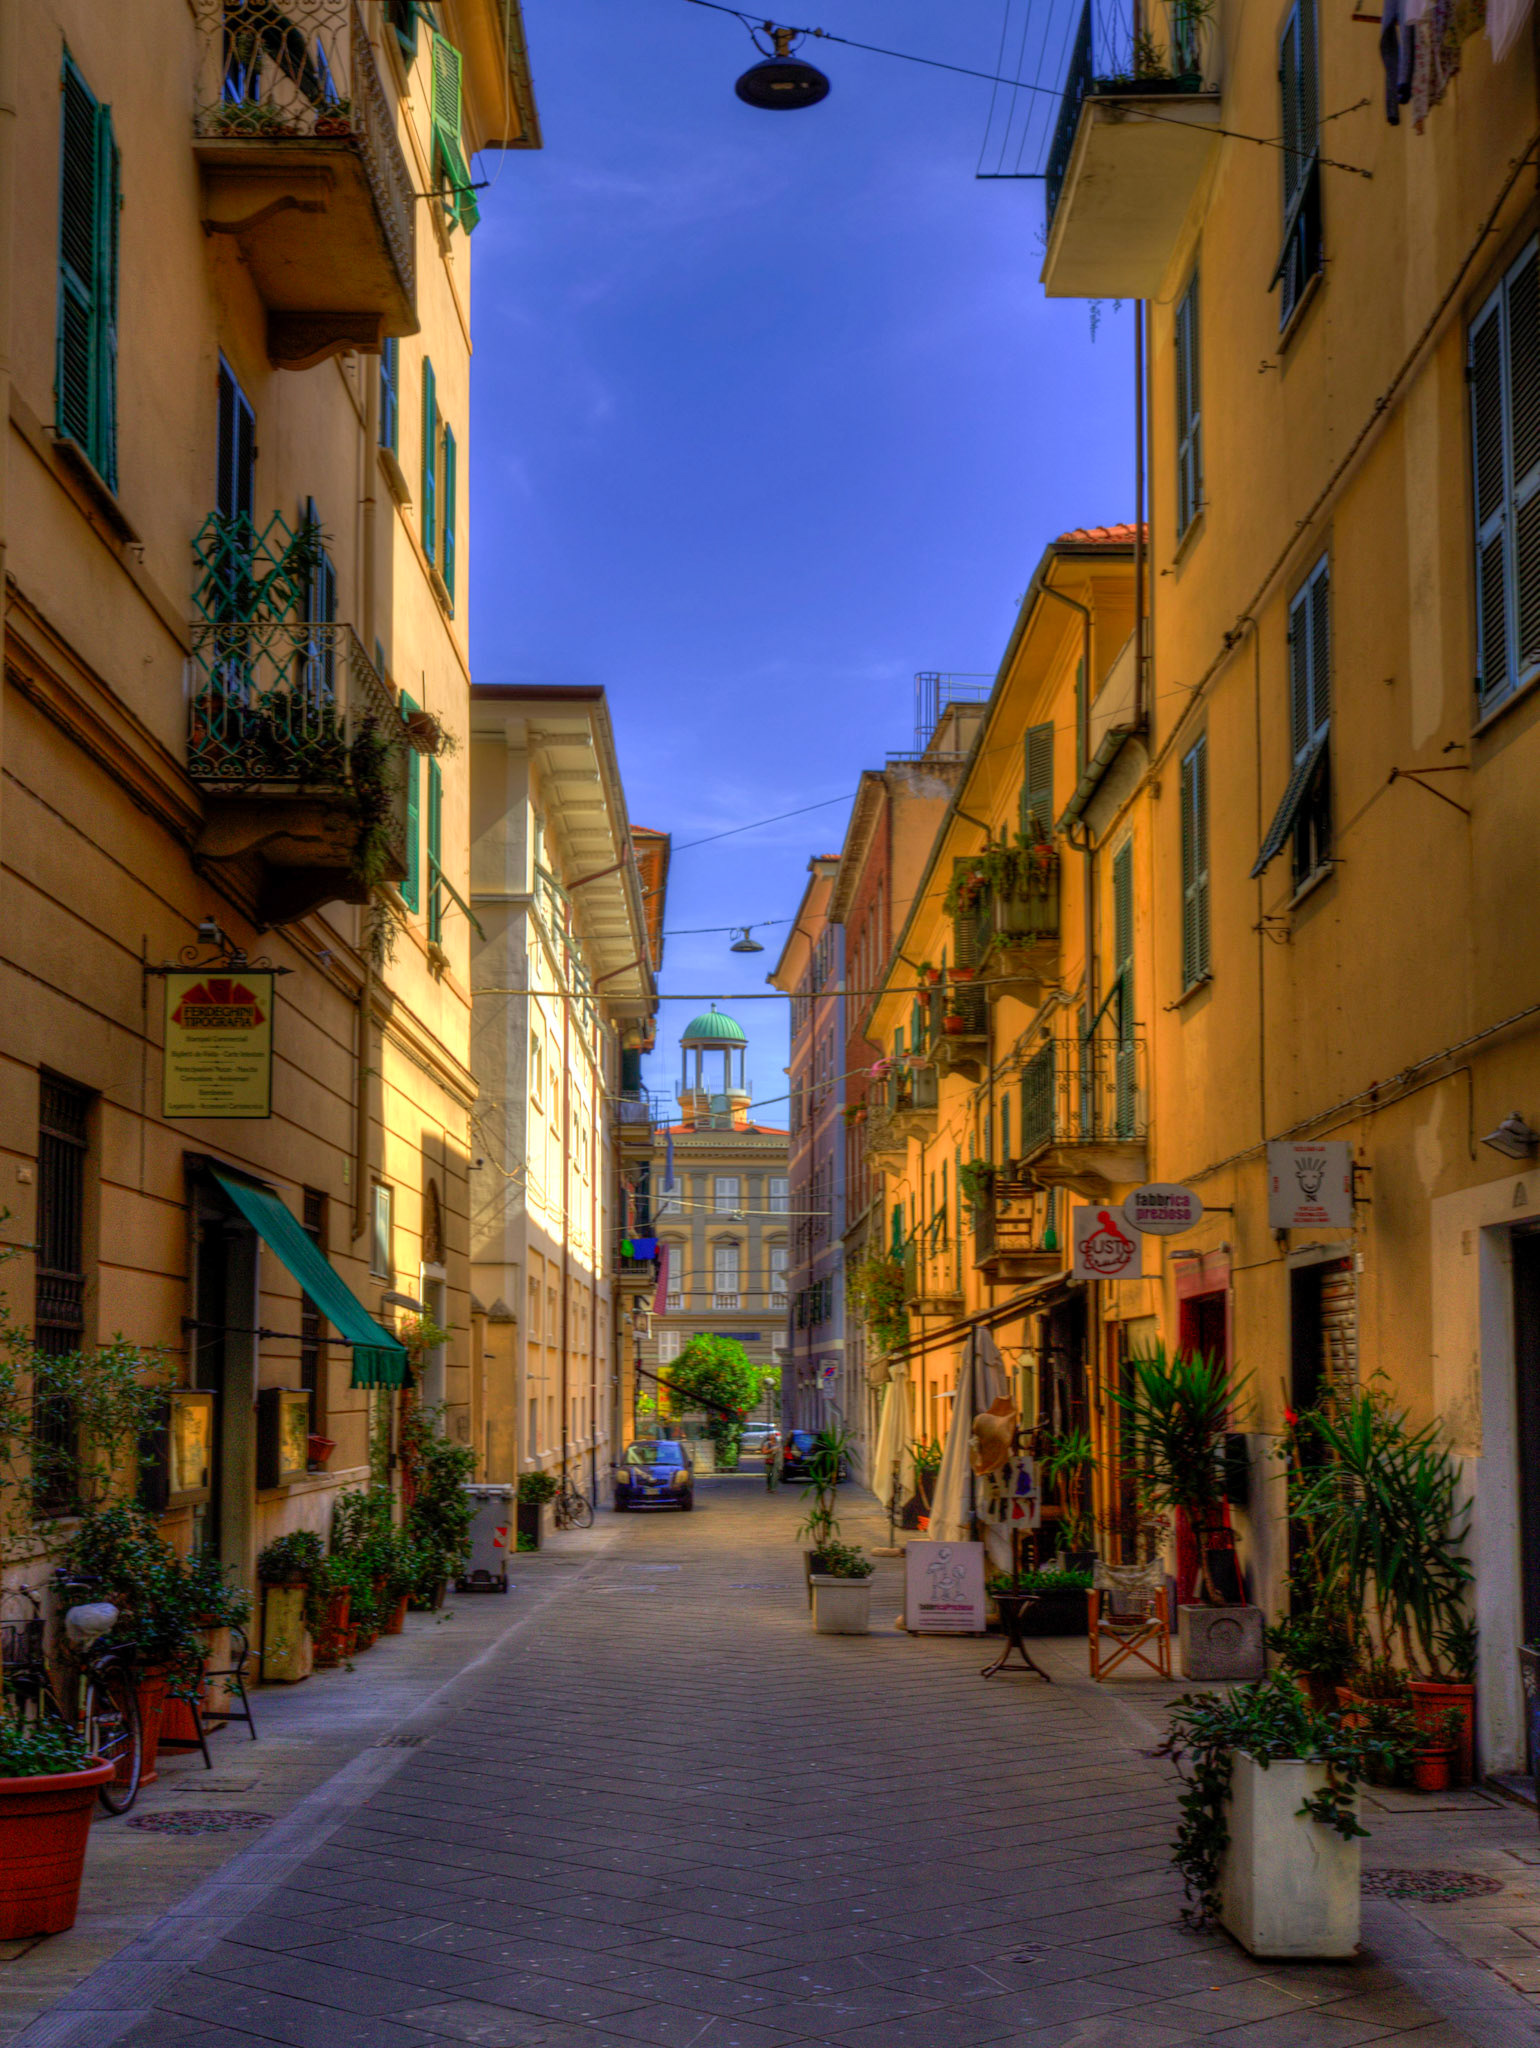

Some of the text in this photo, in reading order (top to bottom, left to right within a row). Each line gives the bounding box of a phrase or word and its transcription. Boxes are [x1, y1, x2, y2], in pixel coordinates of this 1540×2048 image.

[184, 1017, 252, 1027] TIPOGRAFIA
[1135, 1192, 1190, 1206] fabbrica
[1135, 1206, 1191, 1221] prezioso
[1078, 1239, 1136, 1254] GUSTO
